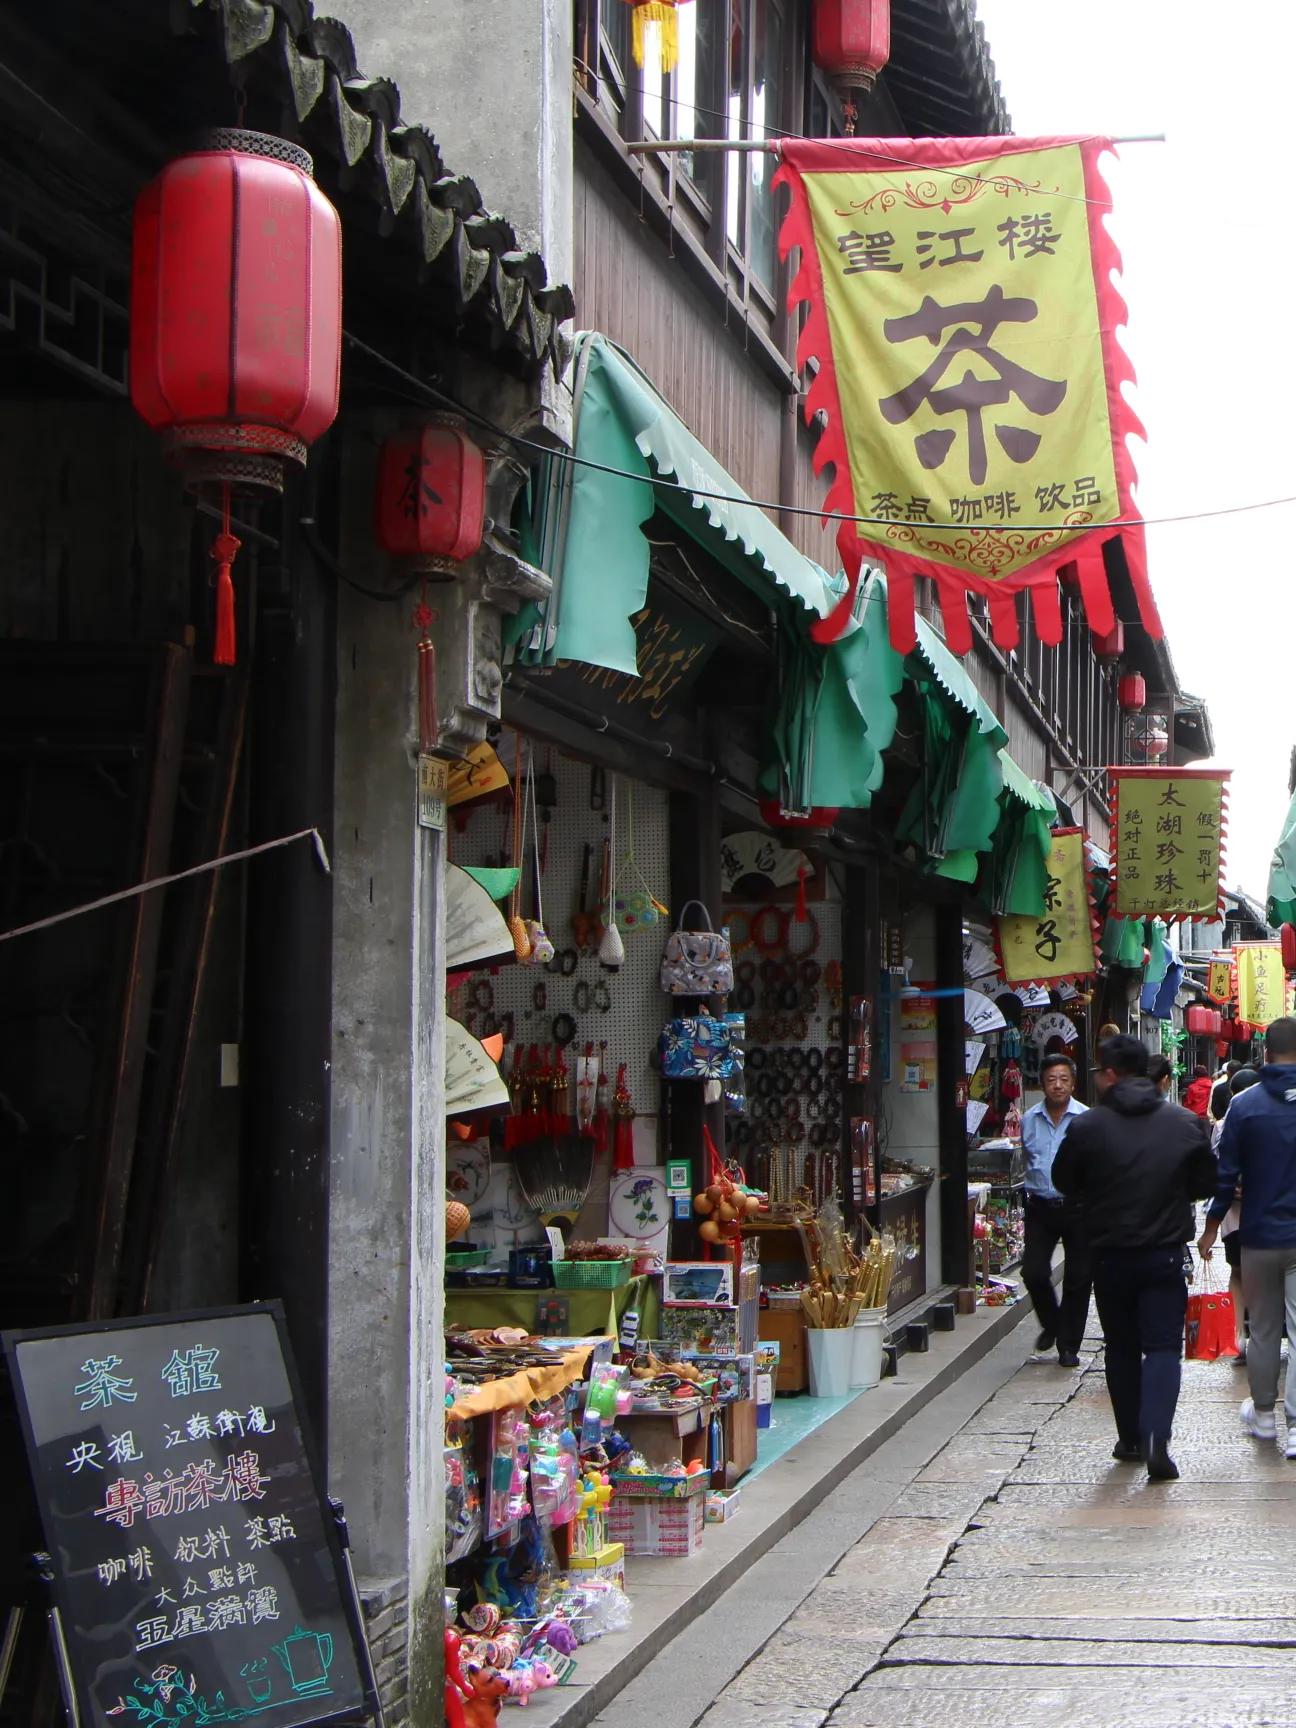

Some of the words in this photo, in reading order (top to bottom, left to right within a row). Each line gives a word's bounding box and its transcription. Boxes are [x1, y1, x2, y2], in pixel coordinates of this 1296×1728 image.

[837, 211, 1063, 275] 望江楼
[878, 283, 1068, 486] 茶
[397, 453, 442, 521] 茶
[869, 491, 936, 524] 茶点
[949, 490, 1021, 525] 咖啡
[1033, 475, 1102, 513] 饮品
[1123, 808, 1143, 880] 绝对正品
[1153, 782, 1187, 895] 太湖珍珠
[1196, 811, 1217, 885] 假一罚十
[65, 1430, 144, 1474] 央視
[97, 1545, 155, 1587] 咖啡
[244, 1514, 297, 1551] 茶點
